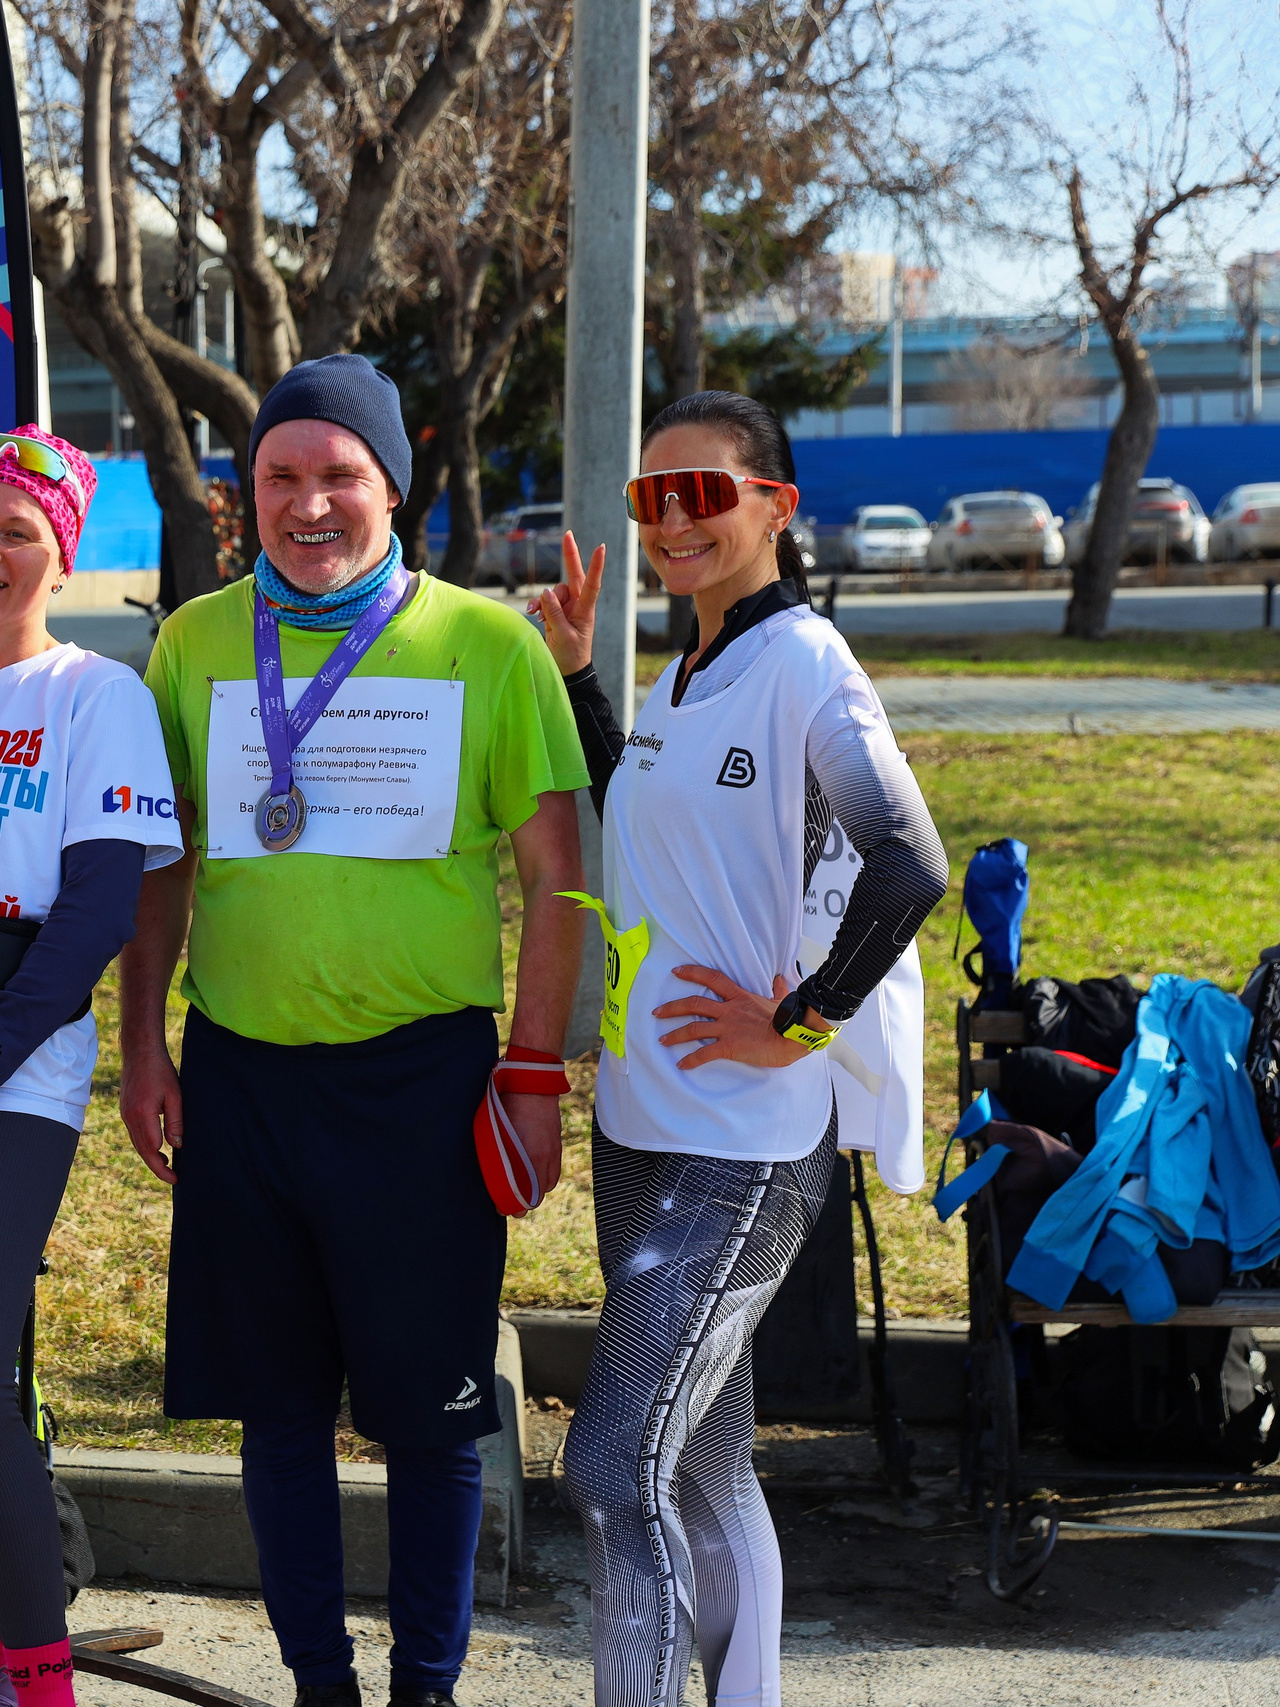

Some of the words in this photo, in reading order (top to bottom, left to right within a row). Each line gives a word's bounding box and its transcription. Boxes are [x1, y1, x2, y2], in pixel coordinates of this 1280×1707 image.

[347, 709, 370, 720] для
[373, 709, 429, 721] другого!
[307, 745, 324, 754] для
[326, 745, 377, 755] подготовки
[379, 746, 427, 756] незрячего
[303, 760, 309, 768] к
[311, 759, 376, 770] полумарафону
[378, 760, 419, 770] Раевича.
[326, 774, 348, 784] берегу
[348, 775, 385, 783] (Монумент
[386, 776, 412, 784] Славы).
[353, 806, 373, 815] его
[377, 804, 424, 817] победа!
